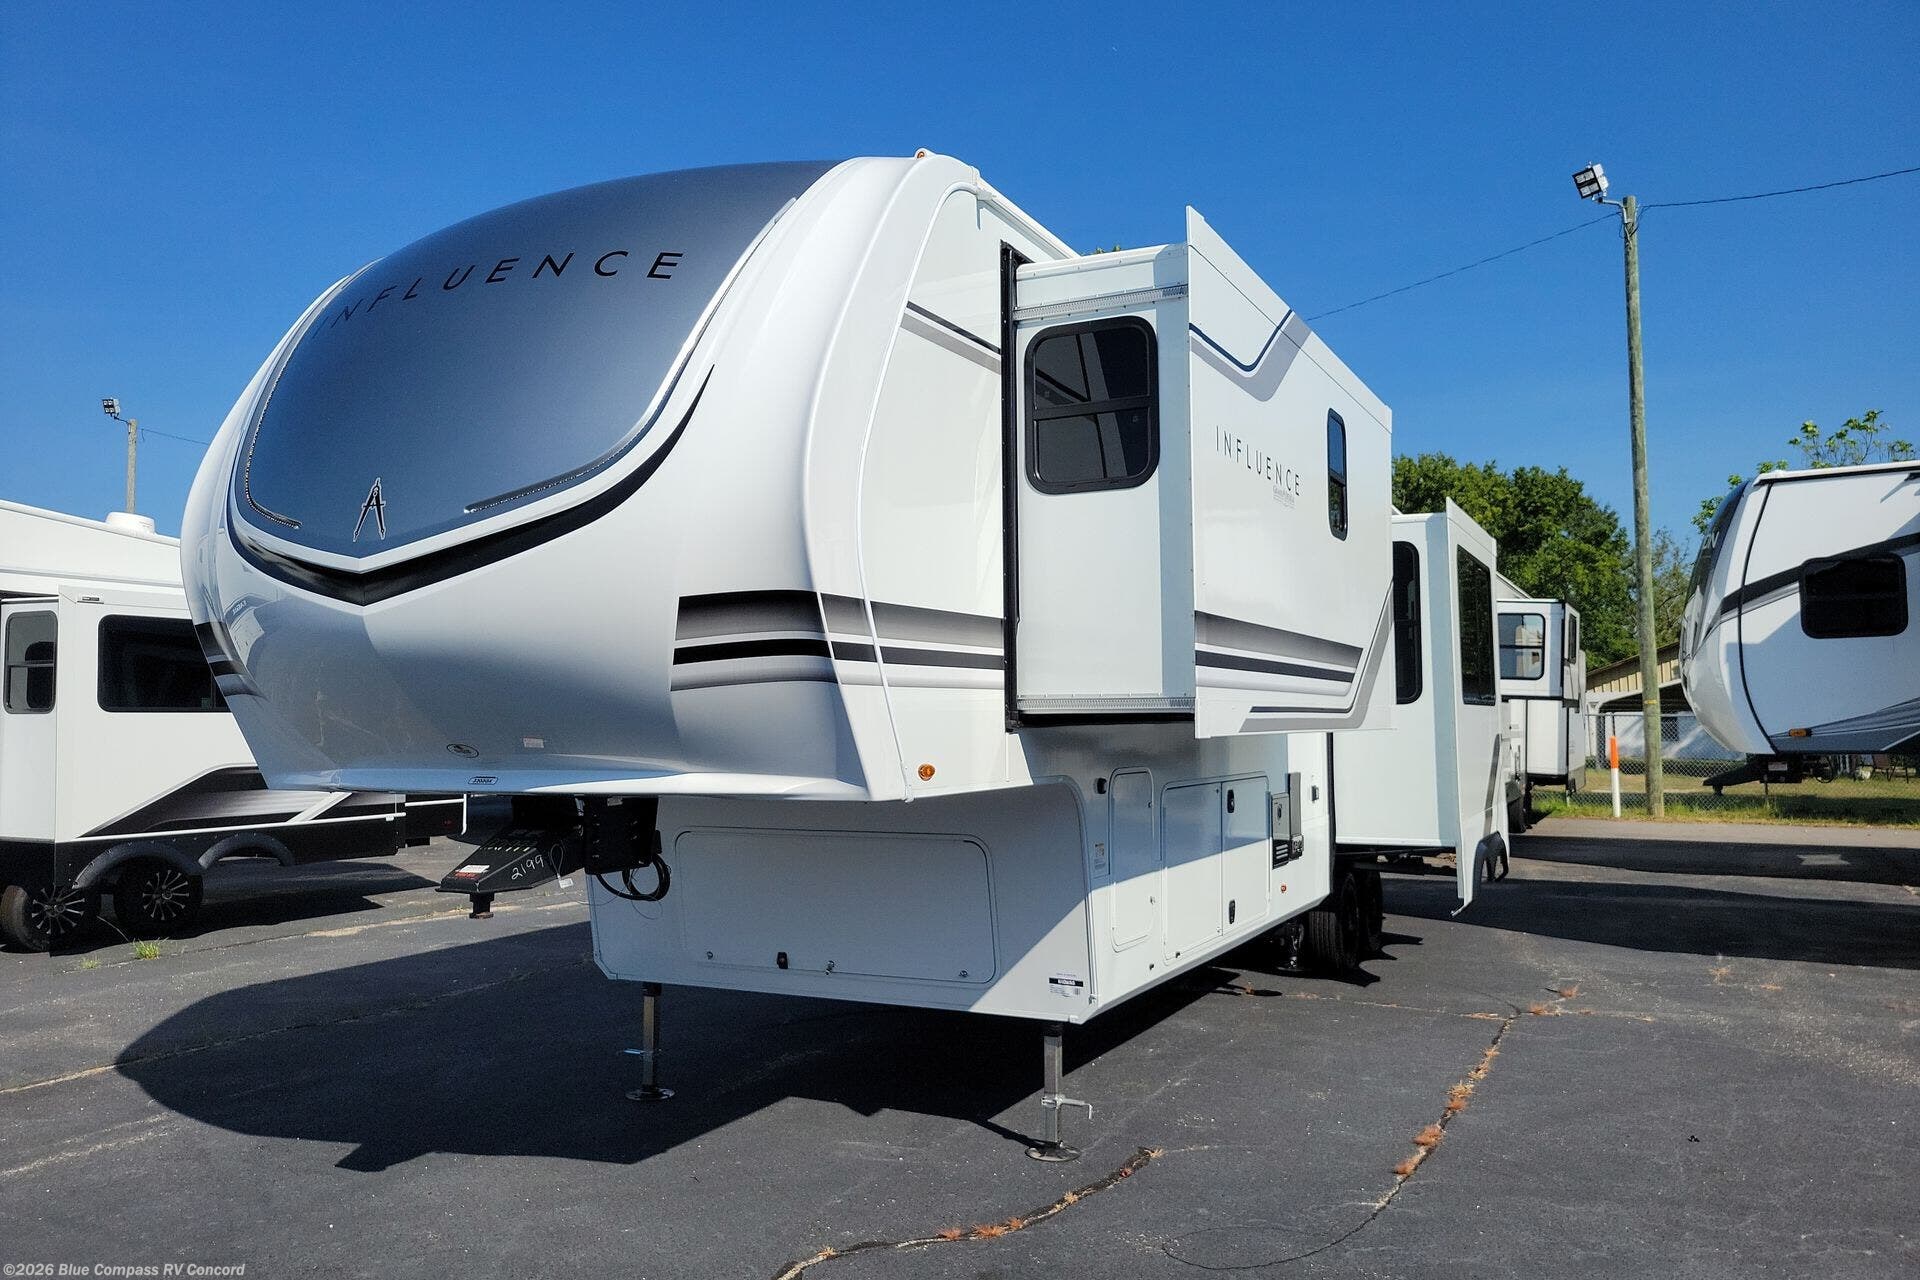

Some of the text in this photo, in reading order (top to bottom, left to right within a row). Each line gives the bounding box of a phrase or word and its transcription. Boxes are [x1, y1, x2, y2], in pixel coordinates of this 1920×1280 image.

[312, 251, 684, 339] INFLUENCE
[1216, 425, 1300, 497] INFLUENCE
[511, 854, 544, 880] 2199
